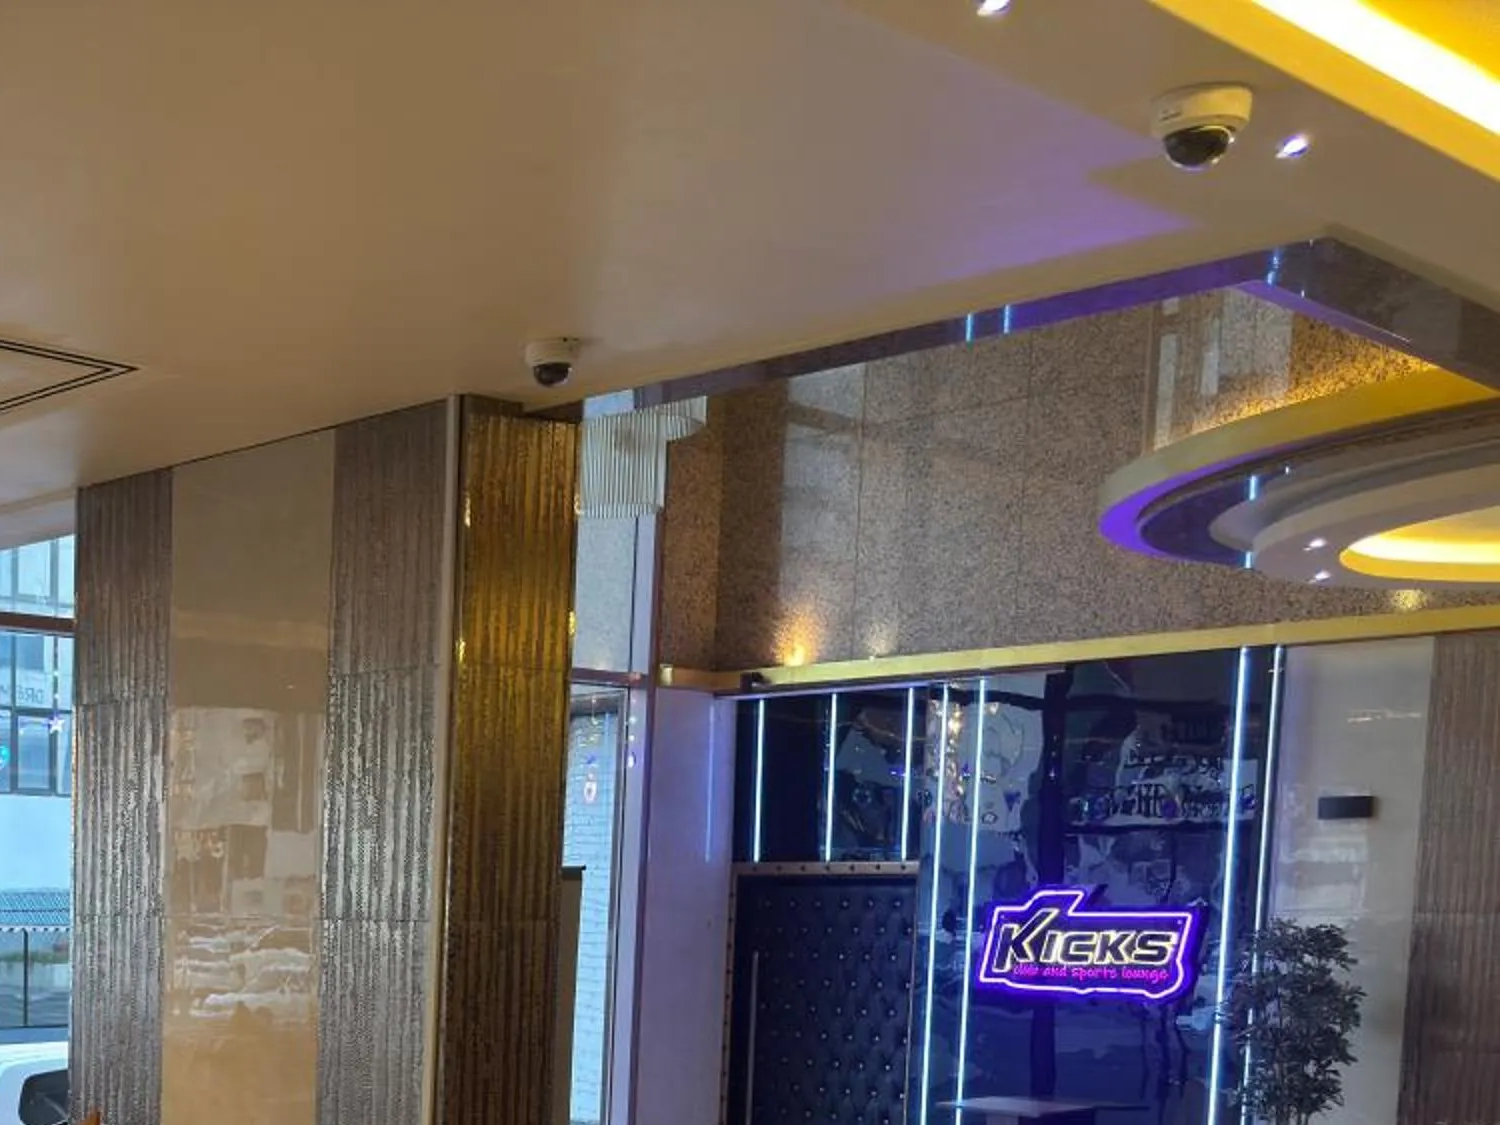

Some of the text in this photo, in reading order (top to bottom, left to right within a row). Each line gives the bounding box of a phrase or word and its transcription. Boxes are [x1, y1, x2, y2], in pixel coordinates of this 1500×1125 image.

[1042, 967, 1067, 977] and
[1071, 967, 1117, 981] sports
[1121, 968, 1169, 984] lounge
